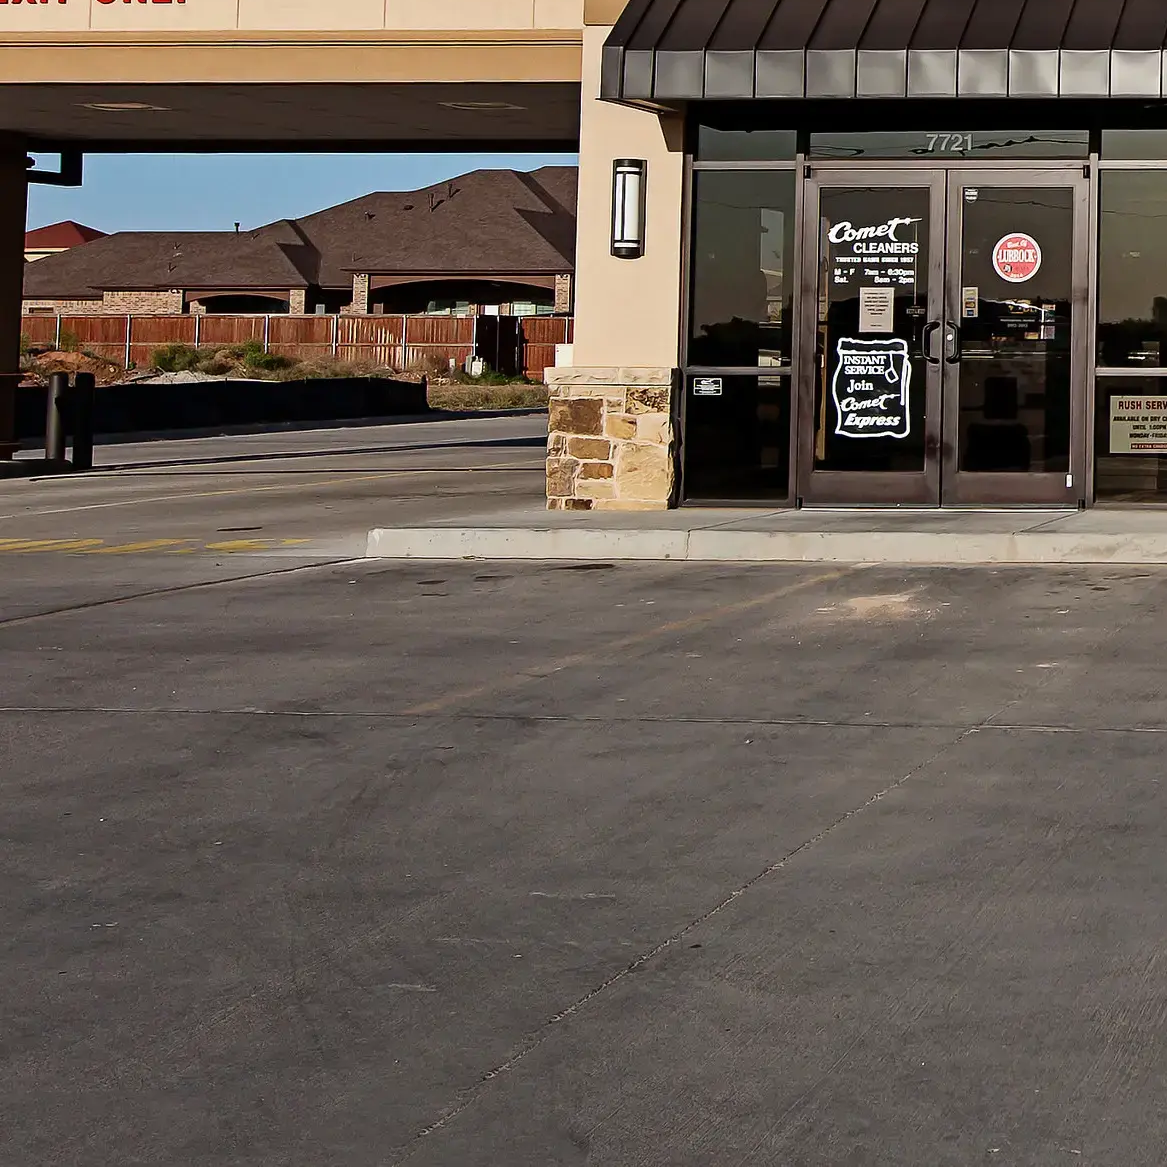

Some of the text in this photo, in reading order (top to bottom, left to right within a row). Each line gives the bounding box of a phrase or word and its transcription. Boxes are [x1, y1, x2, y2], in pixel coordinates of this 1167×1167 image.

[926, 134, 972, 150] 7721
[828, 218, 922, 243] Comet
[853, 243, 919, 254] CLEANERS
[999, 249, 1035, 262] LUBBOCK
[844, 356, 886, 365] INSTANT
[844, 366, 885, 375] SERVICE
[847, 380, 873, 393] Join
[840, 394, 900, 411] Comet
[1118, 401, 1142, 410] RUSH
[844, 413, 901, 428] Express
